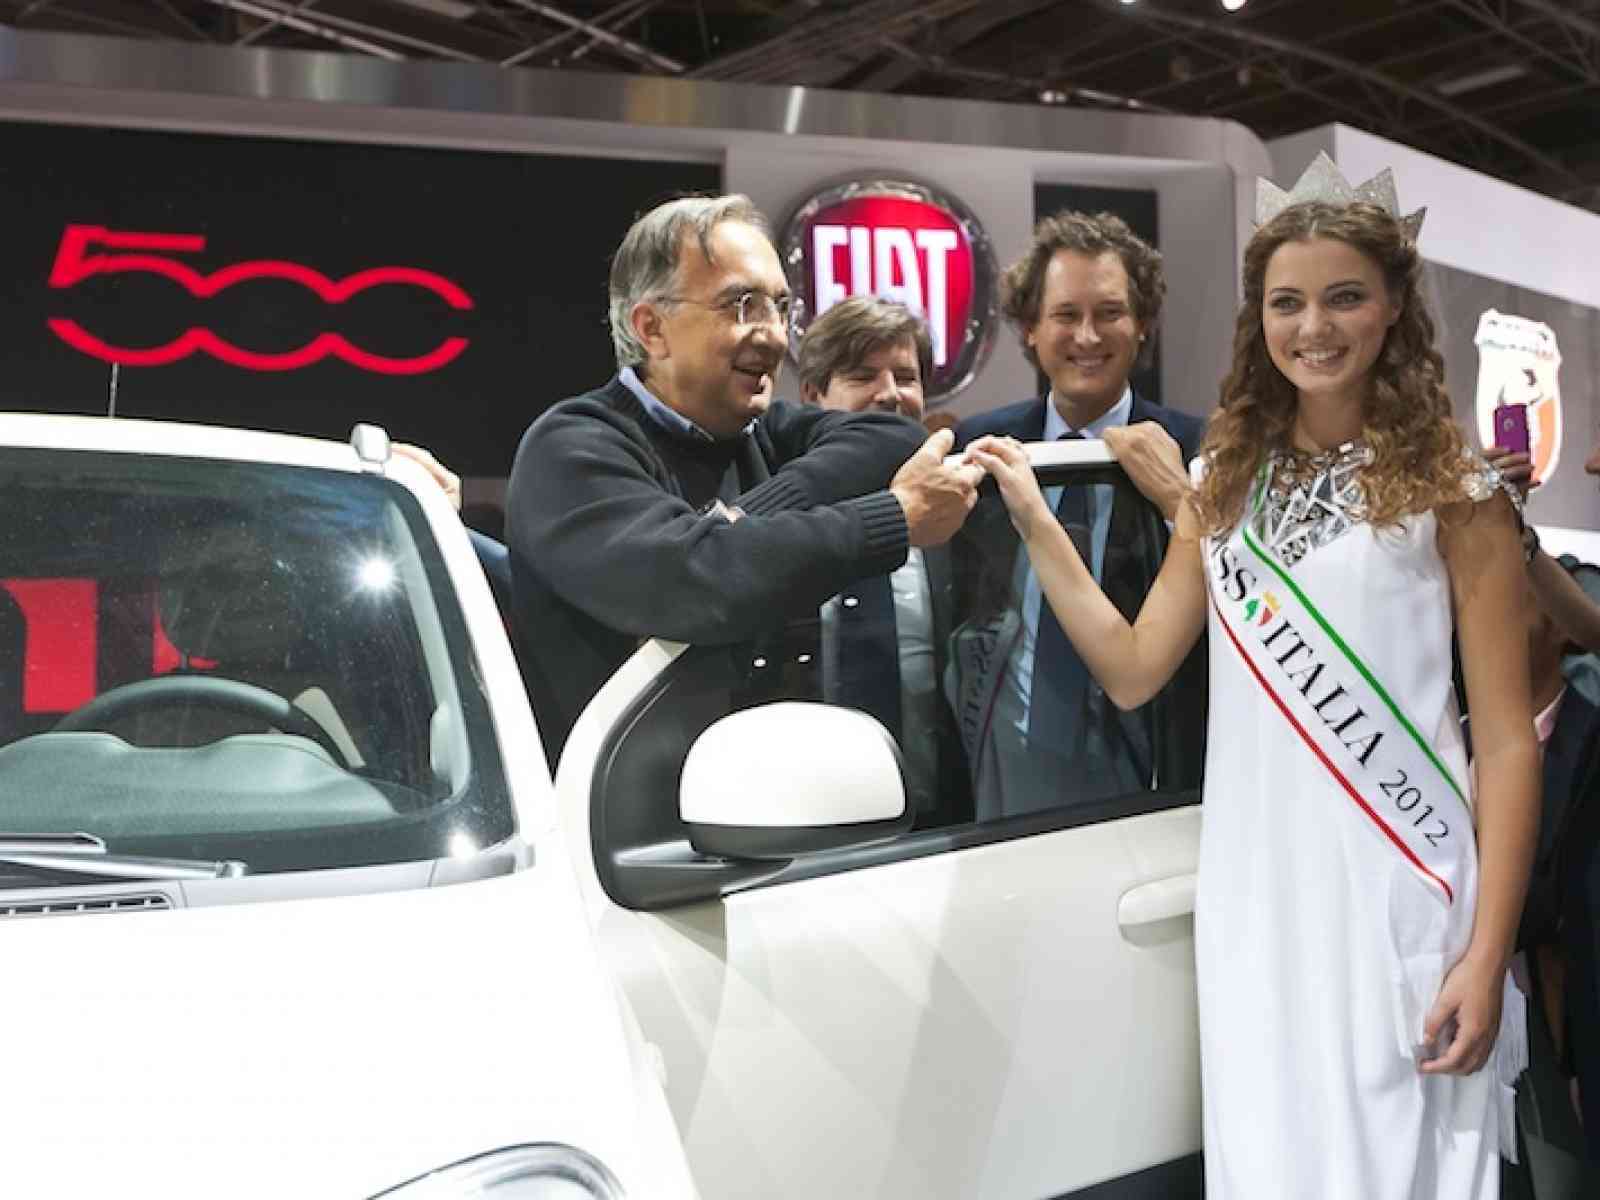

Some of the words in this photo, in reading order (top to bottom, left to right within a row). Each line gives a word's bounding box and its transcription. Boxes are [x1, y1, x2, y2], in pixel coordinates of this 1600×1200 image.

[47, 224, 474, 375] 500
[1261, 619, 1385, 768] ITALIA
[1379, 768, 1449, 848] 2012
